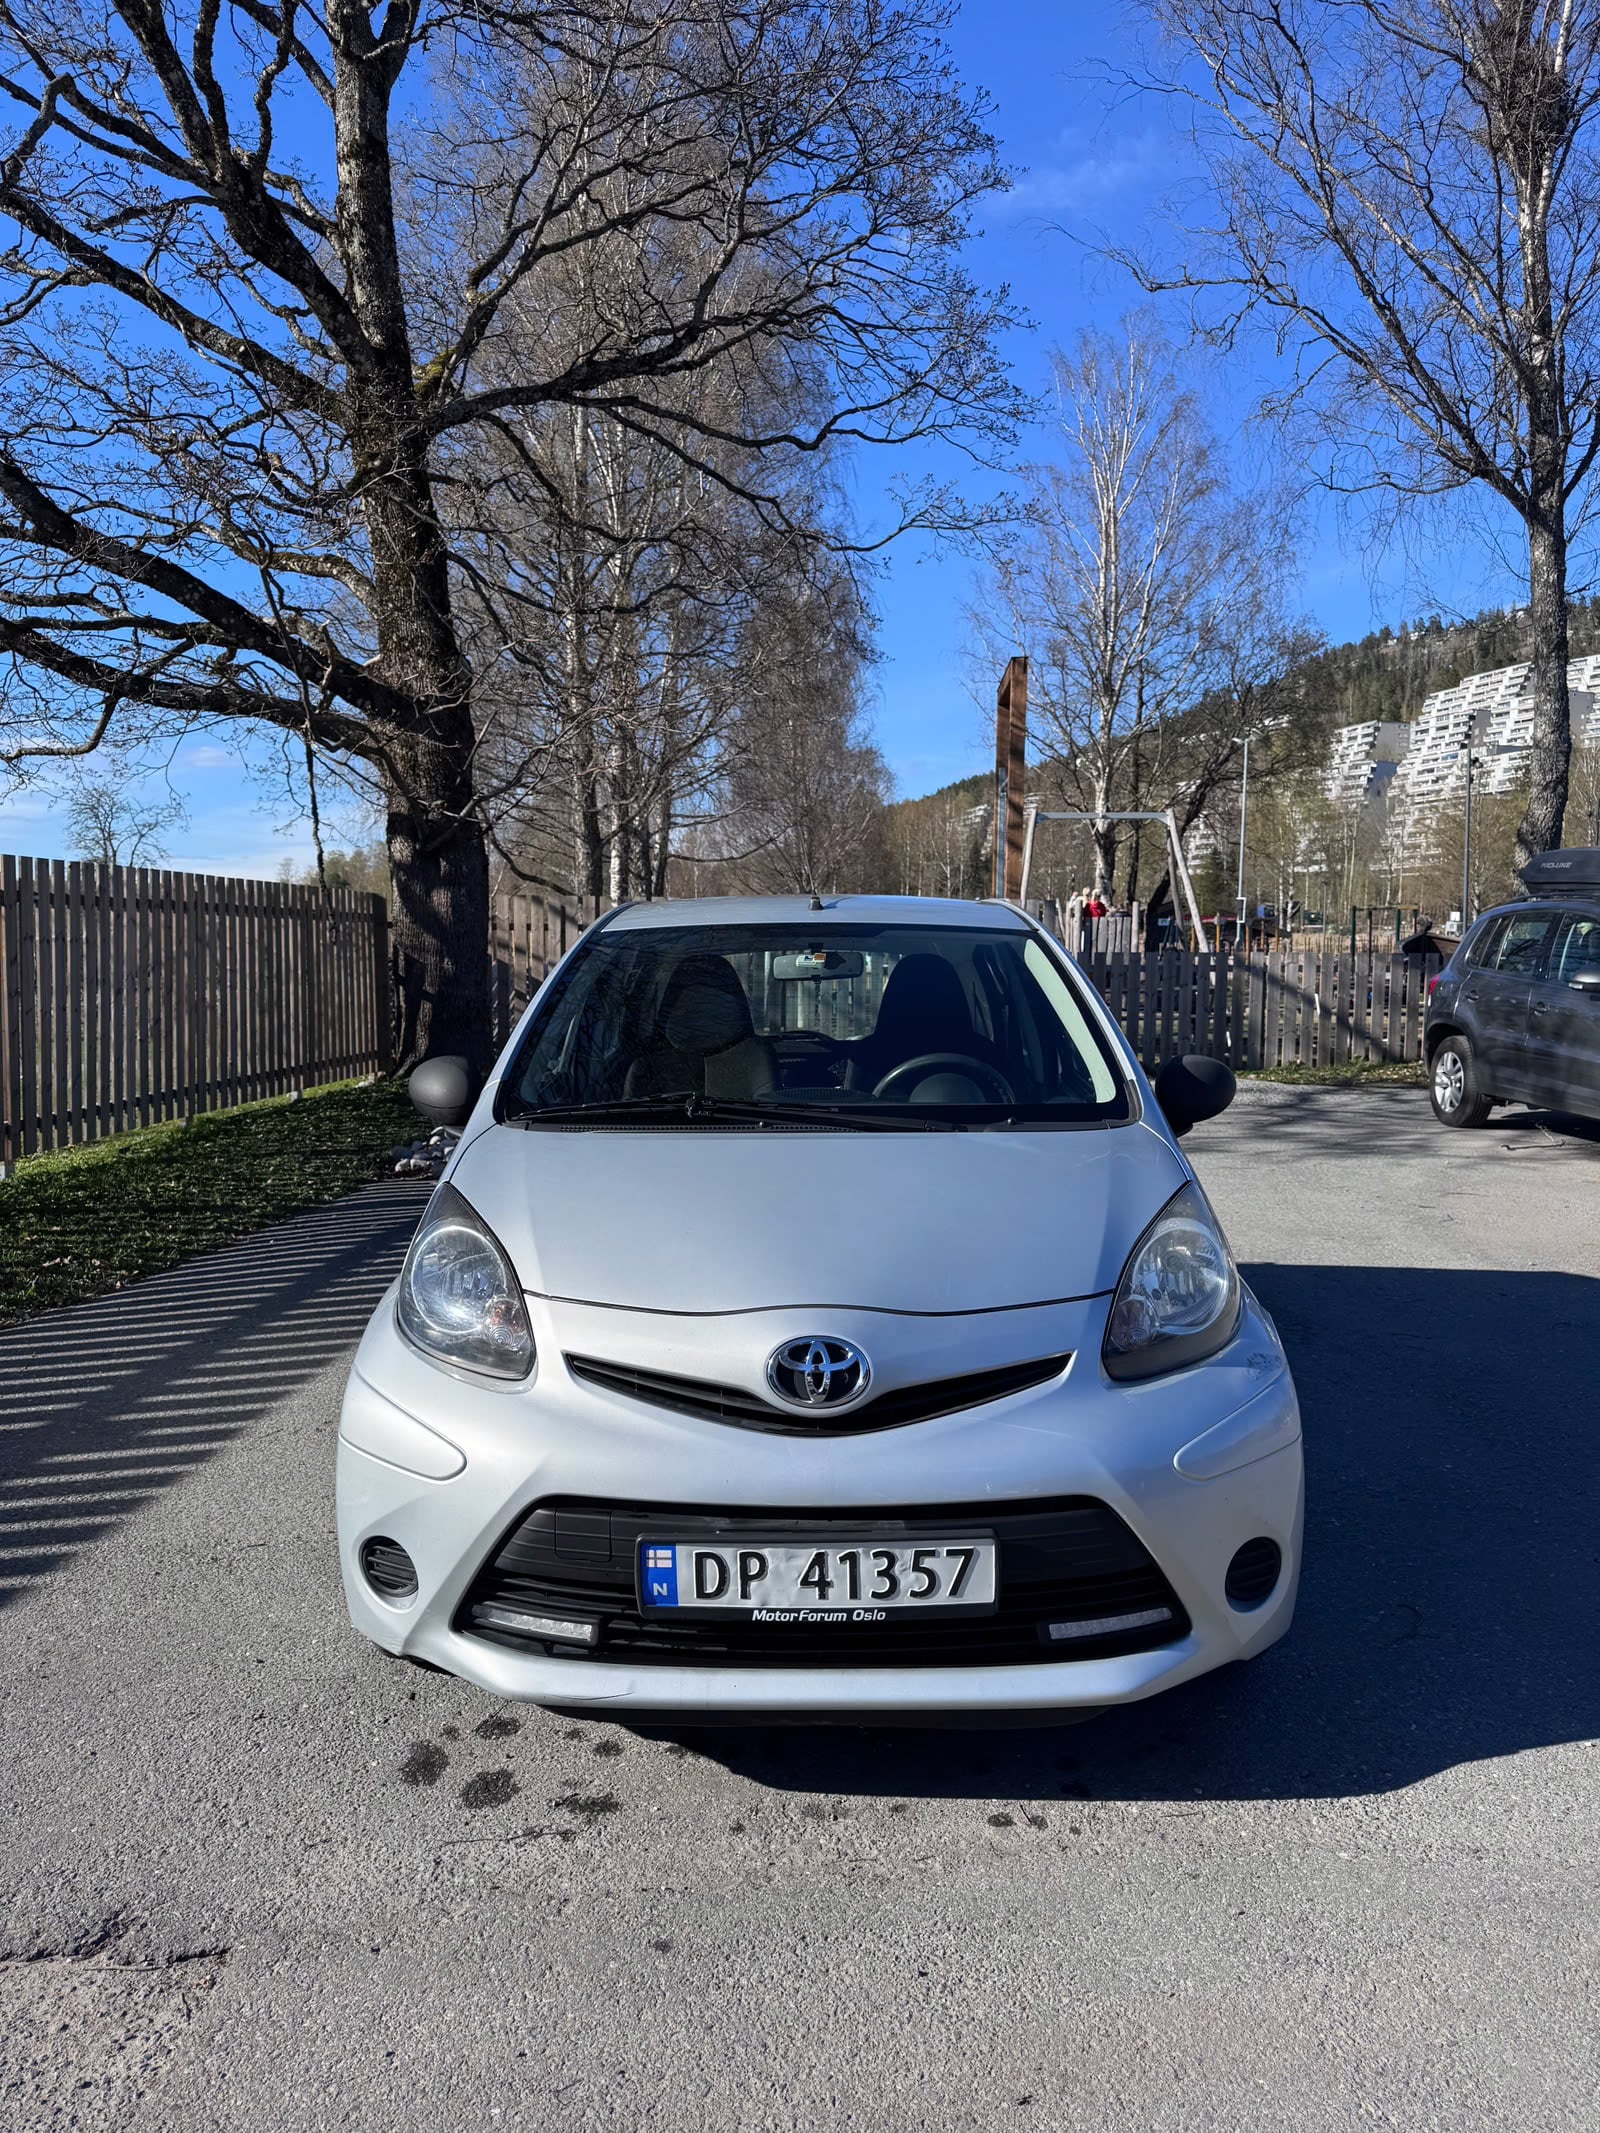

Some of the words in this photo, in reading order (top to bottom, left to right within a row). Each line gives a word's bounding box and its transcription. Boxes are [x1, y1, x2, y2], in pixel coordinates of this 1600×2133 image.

[692, 1550, 768, 1600] DP
[798, 1548, 978, 1600] 41357
[653, 1582, 668, 1596] N
[852, 1608, 887, 1621] Oslo
